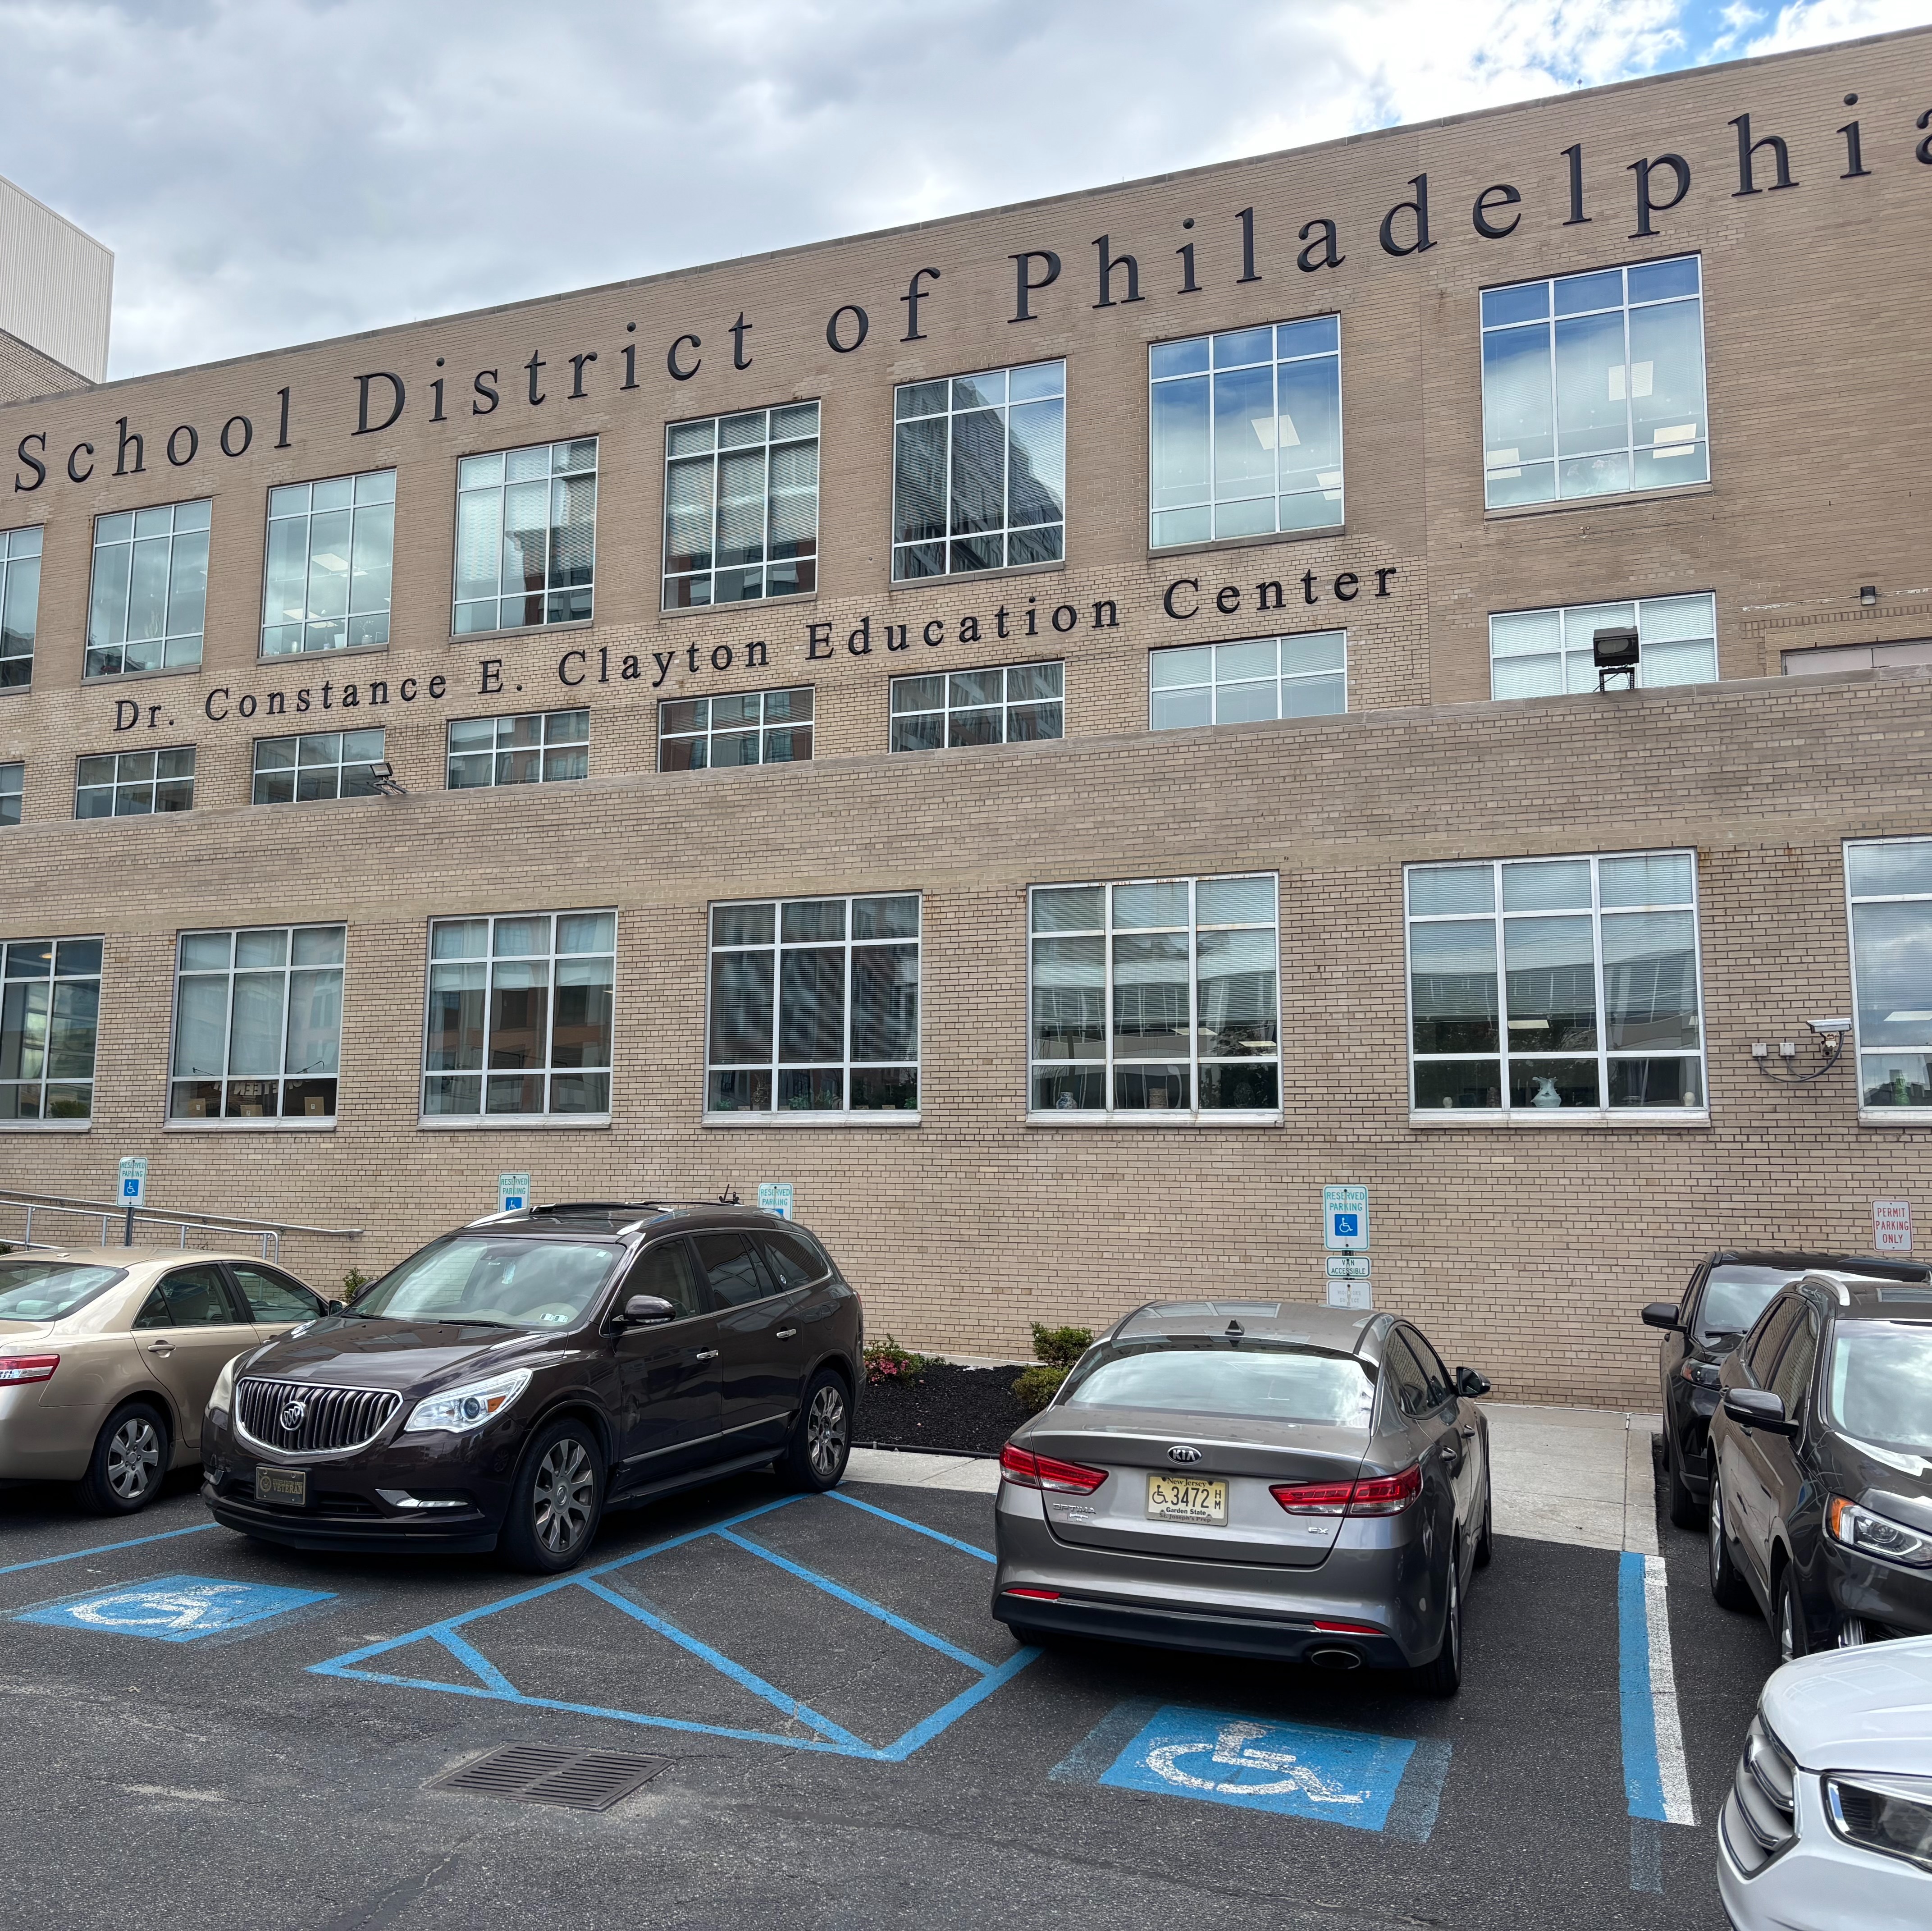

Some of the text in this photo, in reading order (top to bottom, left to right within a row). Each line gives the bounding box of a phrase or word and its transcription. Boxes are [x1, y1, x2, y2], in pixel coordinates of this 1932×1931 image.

[14, 386, 292, 493] School
[351, 311, 753, 436] District
[826, 267, 941, 353] of
[113, 567, 1397, 731] Dr. Constance E. Clayton Education Center
[1326, 1192, 1365, 1200] RESERVED
[1329, 1203, 1363, 1211] PARKING
[1877, 1208, 1905, 1217] PERMIT
[1876, 1221, 1909, 1231] PARKING
[1882, 1234, 1903, 1244] ONLY
[1173, 1449, 1196, 1461] KIA
[1184, 1478, 1208, 1488] Jersey
[272, 1483, 302, 1495] VETERAN
[1170, 1486, 1210, 1509] 3472
[1053, 1503, 1096, 1514] OPTIMA
[1308, 1527, 1329, 1535] EX
